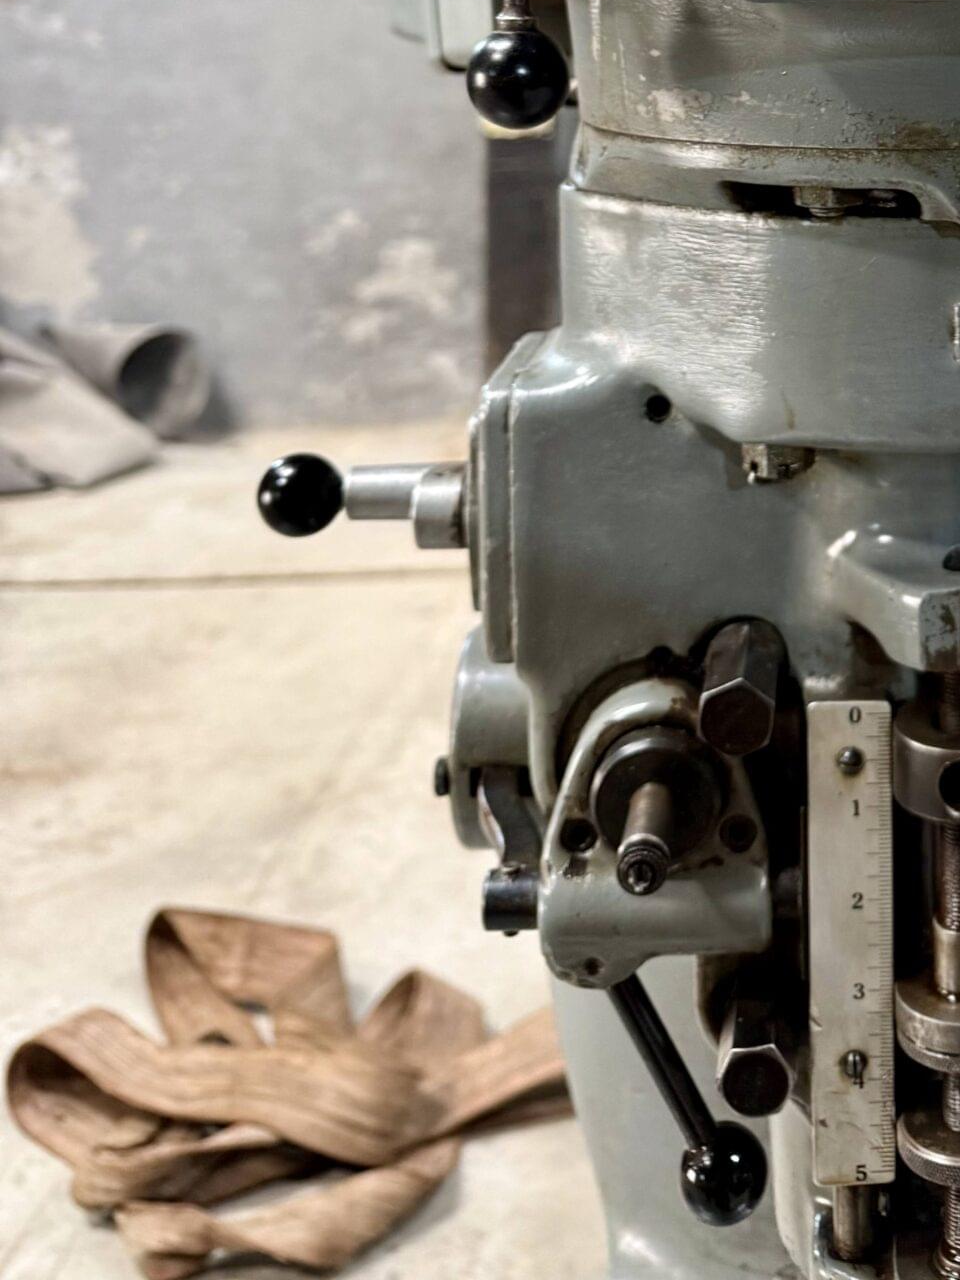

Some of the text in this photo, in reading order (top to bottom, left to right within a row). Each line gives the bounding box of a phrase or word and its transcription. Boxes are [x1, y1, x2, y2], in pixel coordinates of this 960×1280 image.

[850, 706, 861, 723] 0
[852, 800, 860, 816] 1
[852, 893, 863, 909] 2
[853, 983, 864, 999] 3
[855, 1165, 867, 1181] 5
